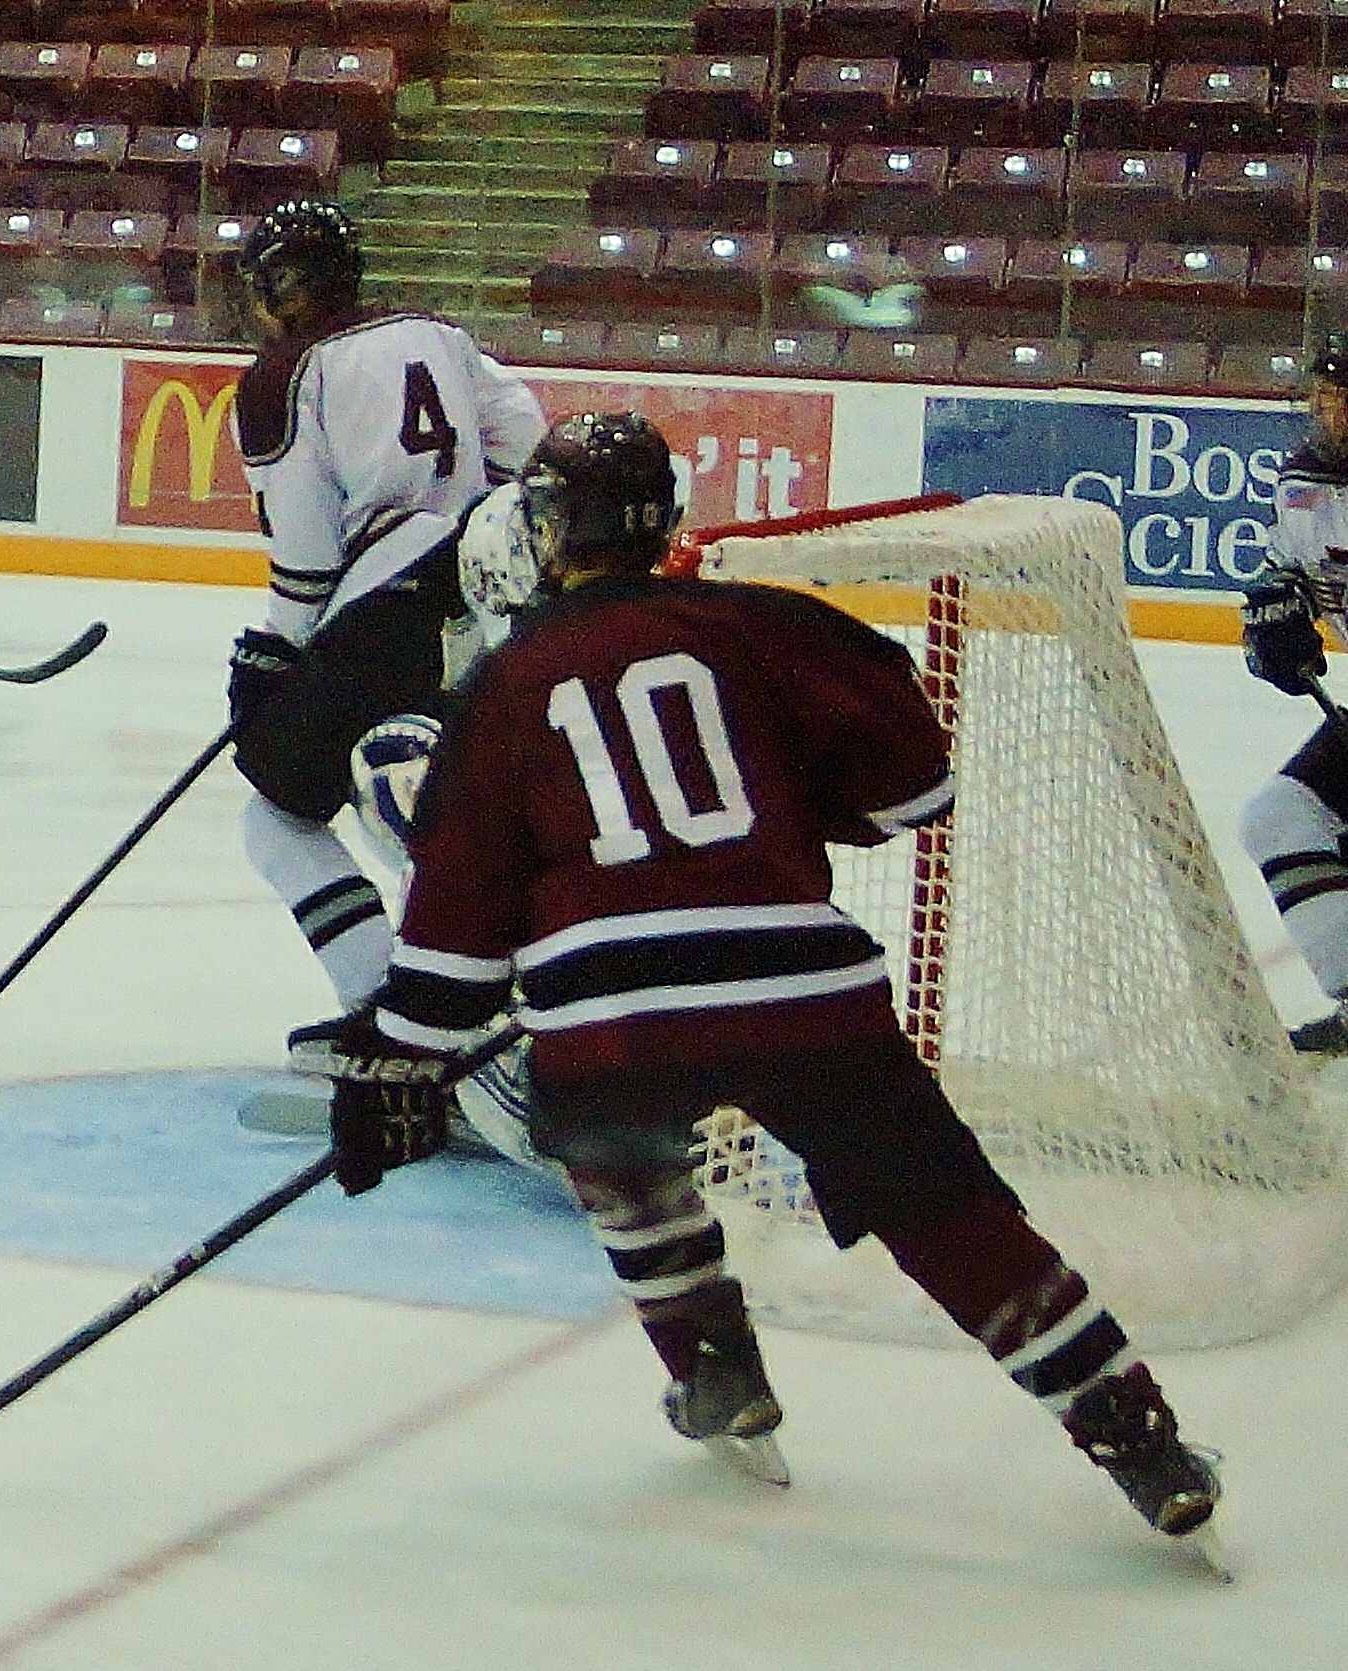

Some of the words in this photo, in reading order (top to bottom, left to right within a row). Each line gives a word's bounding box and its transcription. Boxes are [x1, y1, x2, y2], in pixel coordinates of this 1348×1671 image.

[398, 360, 456, 479] 4
[1126, 412, 1284, 503] Bos
[548, 651, 754, 866] 10
